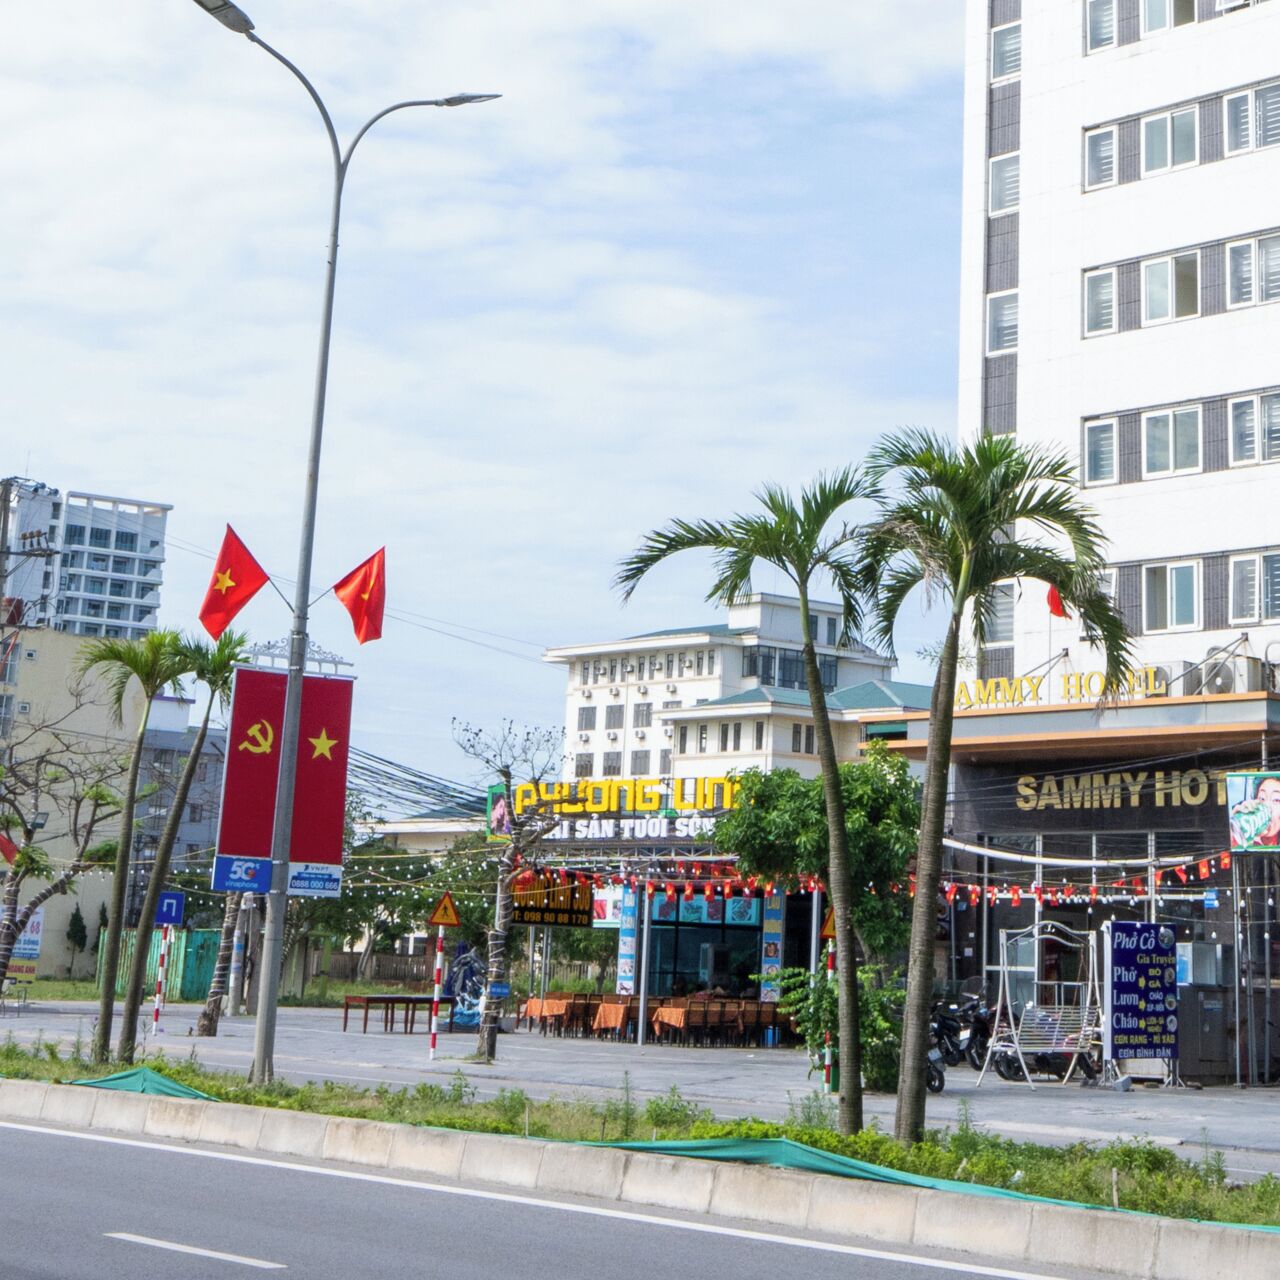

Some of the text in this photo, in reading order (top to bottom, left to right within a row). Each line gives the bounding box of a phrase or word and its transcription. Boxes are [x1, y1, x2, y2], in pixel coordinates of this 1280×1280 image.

[953, 675, 1042, 706] AMMY
[1015, 771, 1149, 811] SAMMY
[575, 813, 615, 839] SẢN
[225, 881, 259, 889] vinaphone
[1113, 931, 1138, 950] Phở
[1137, 953, 1150, 964] Gia
[1113, 966, 1137, 982] Phở
[1113, 989, 1139, 1005] Lươn
[1113, 1012, 1138, 1029] Cháo
